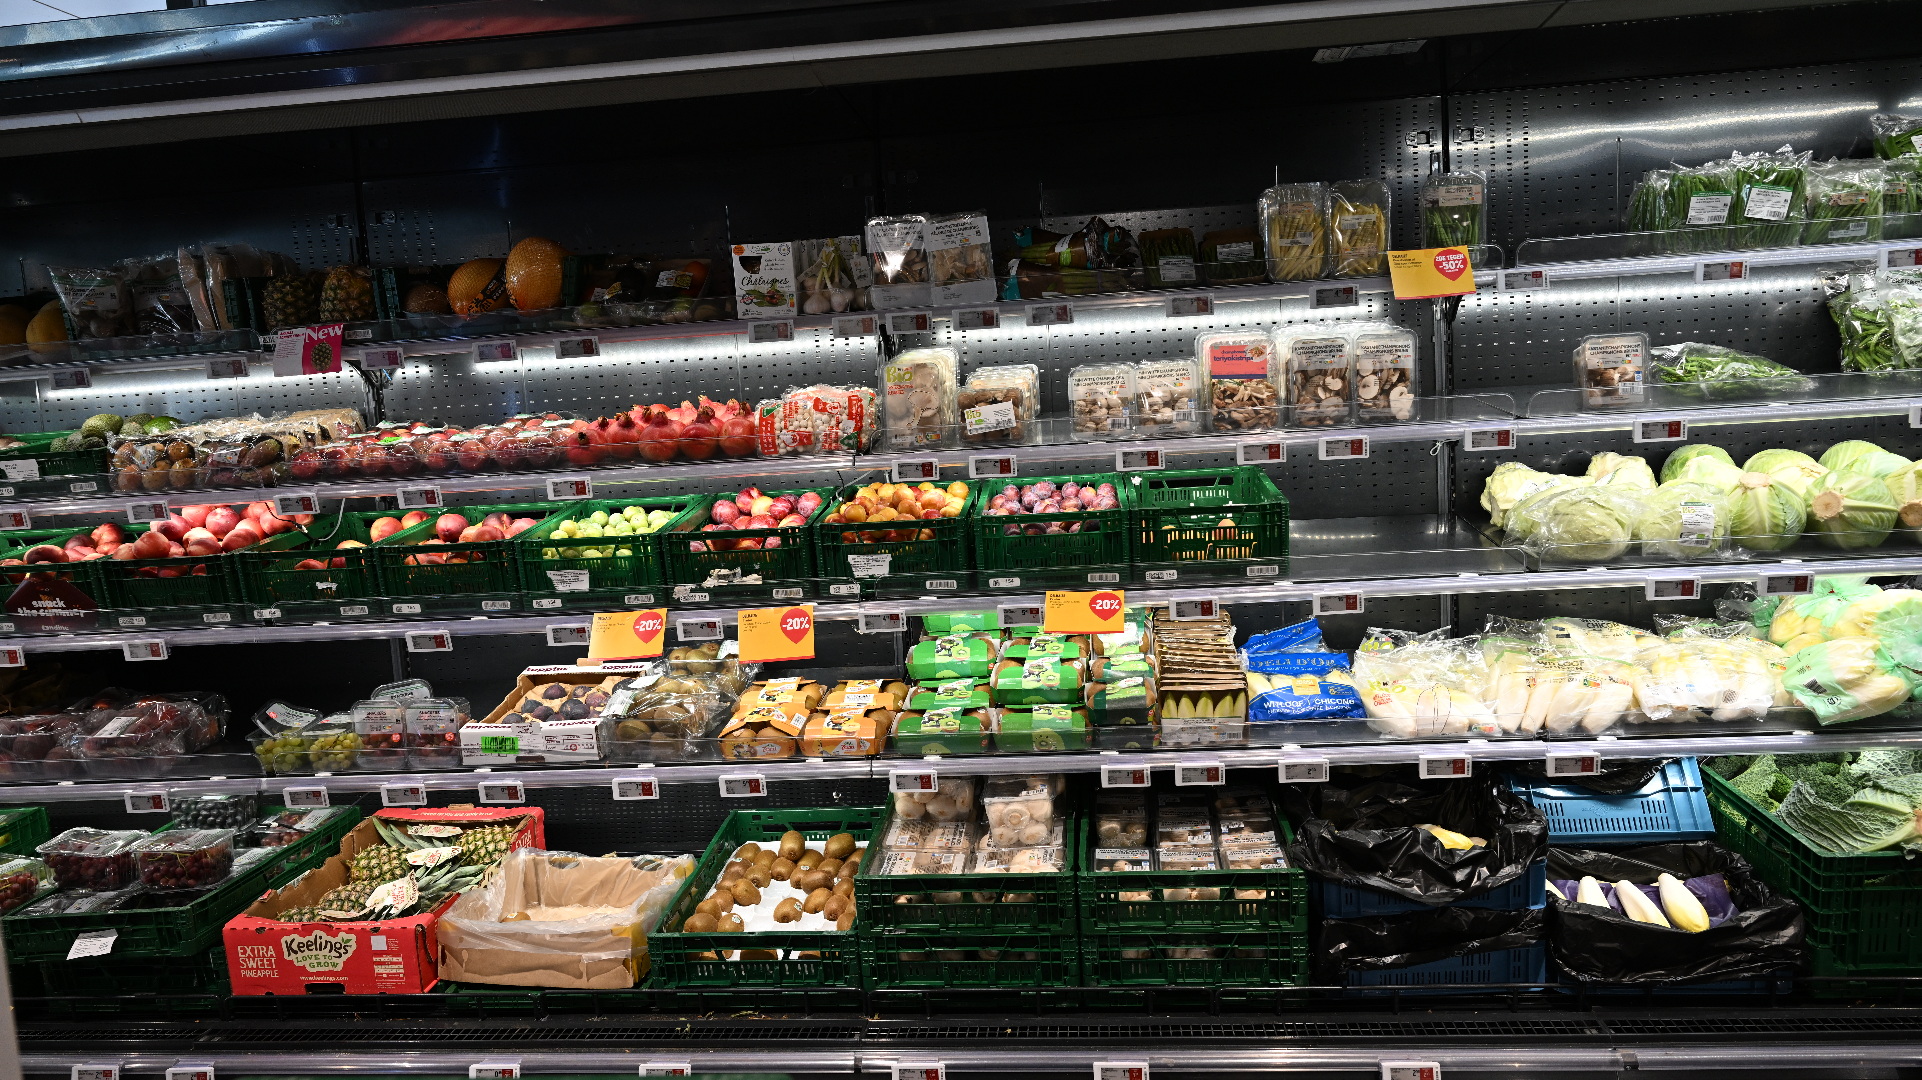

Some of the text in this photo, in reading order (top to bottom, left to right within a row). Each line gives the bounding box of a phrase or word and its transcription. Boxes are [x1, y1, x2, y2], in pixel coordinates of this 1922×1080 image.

[1439, 260, 1464, 270] -50%
[305, 324, 344, 343] New
[1091, 599, 1120, 609] -20%
[635, 617, 662, 631] -20%
[782, 616, 809, 630] -20%
[237, 945, 276, 958] EXTRA
[284, 934, 349, 959] Keelings
[239, 958, 276, 969] SWEET
[296, 954, 320, 964] LOVE
[308, 961, 339, 969] GROW
[240, 969, 280, 978] PINEAPPLE
